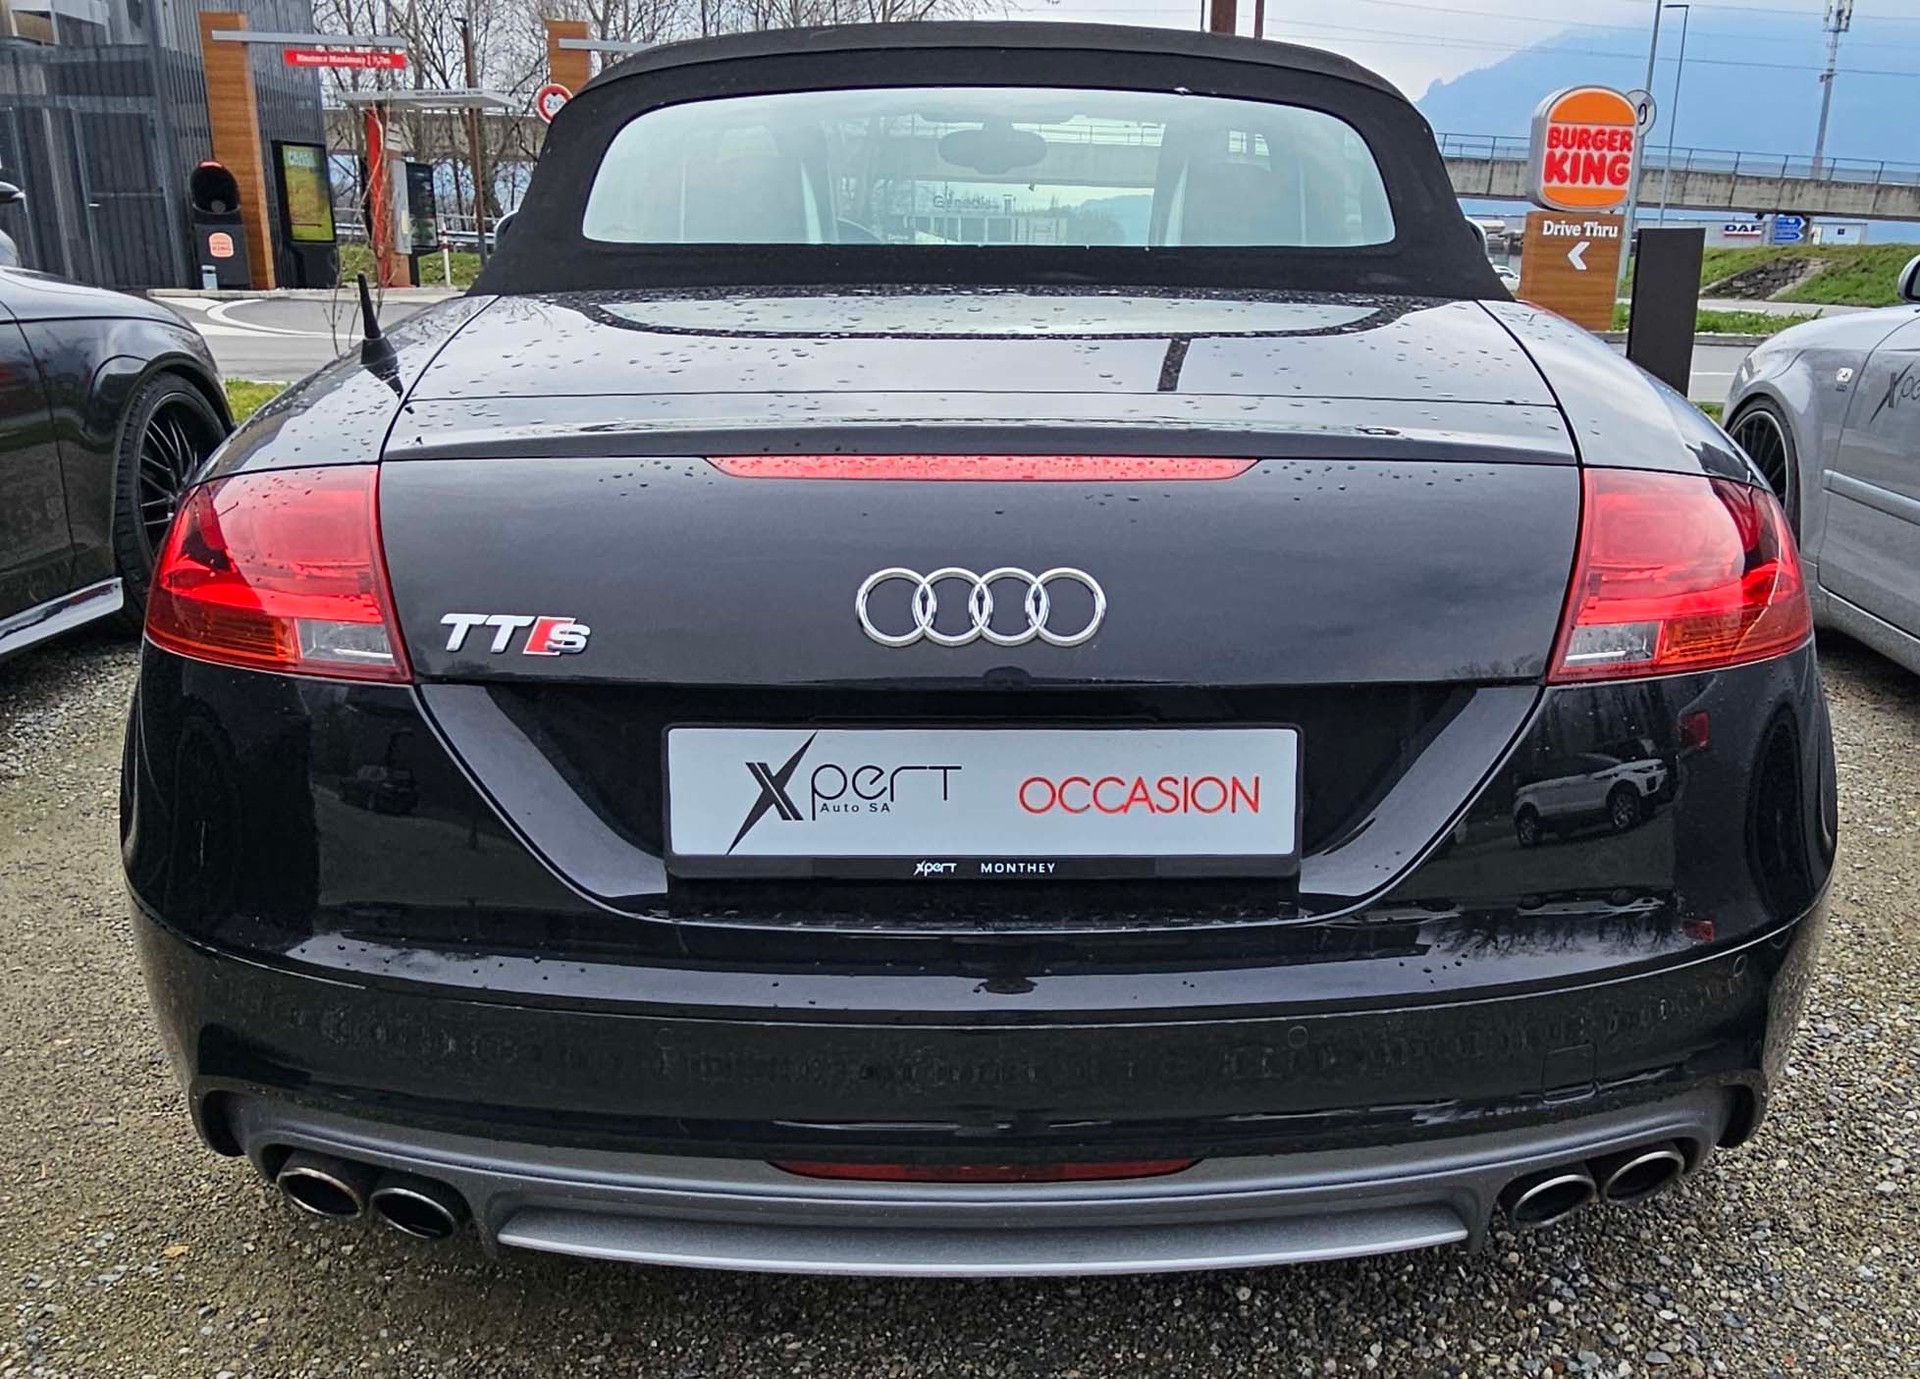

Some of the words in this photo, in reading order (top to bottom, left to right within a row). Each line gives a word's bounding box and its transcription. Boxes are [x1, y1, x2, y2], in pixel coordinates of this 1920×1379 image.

[1638, 103, 1648, 126] 0
[1546, 125, 1634, 153] BURGER
[1543, 151, 1630, 186] KING
[1542, 220, 1582, 236] Drive
[1583, 221, 1618, 238] Thru
[1724, 224, 1762, 233] DAF
[440, 612, 592, 657] TTS
[1018, 775, 1262, 815] OCCASION
[820, 802, 861, 813] Auto
[868, 802, 891, 813] SA
[980, 862, 1056, 873] MONTHEY
